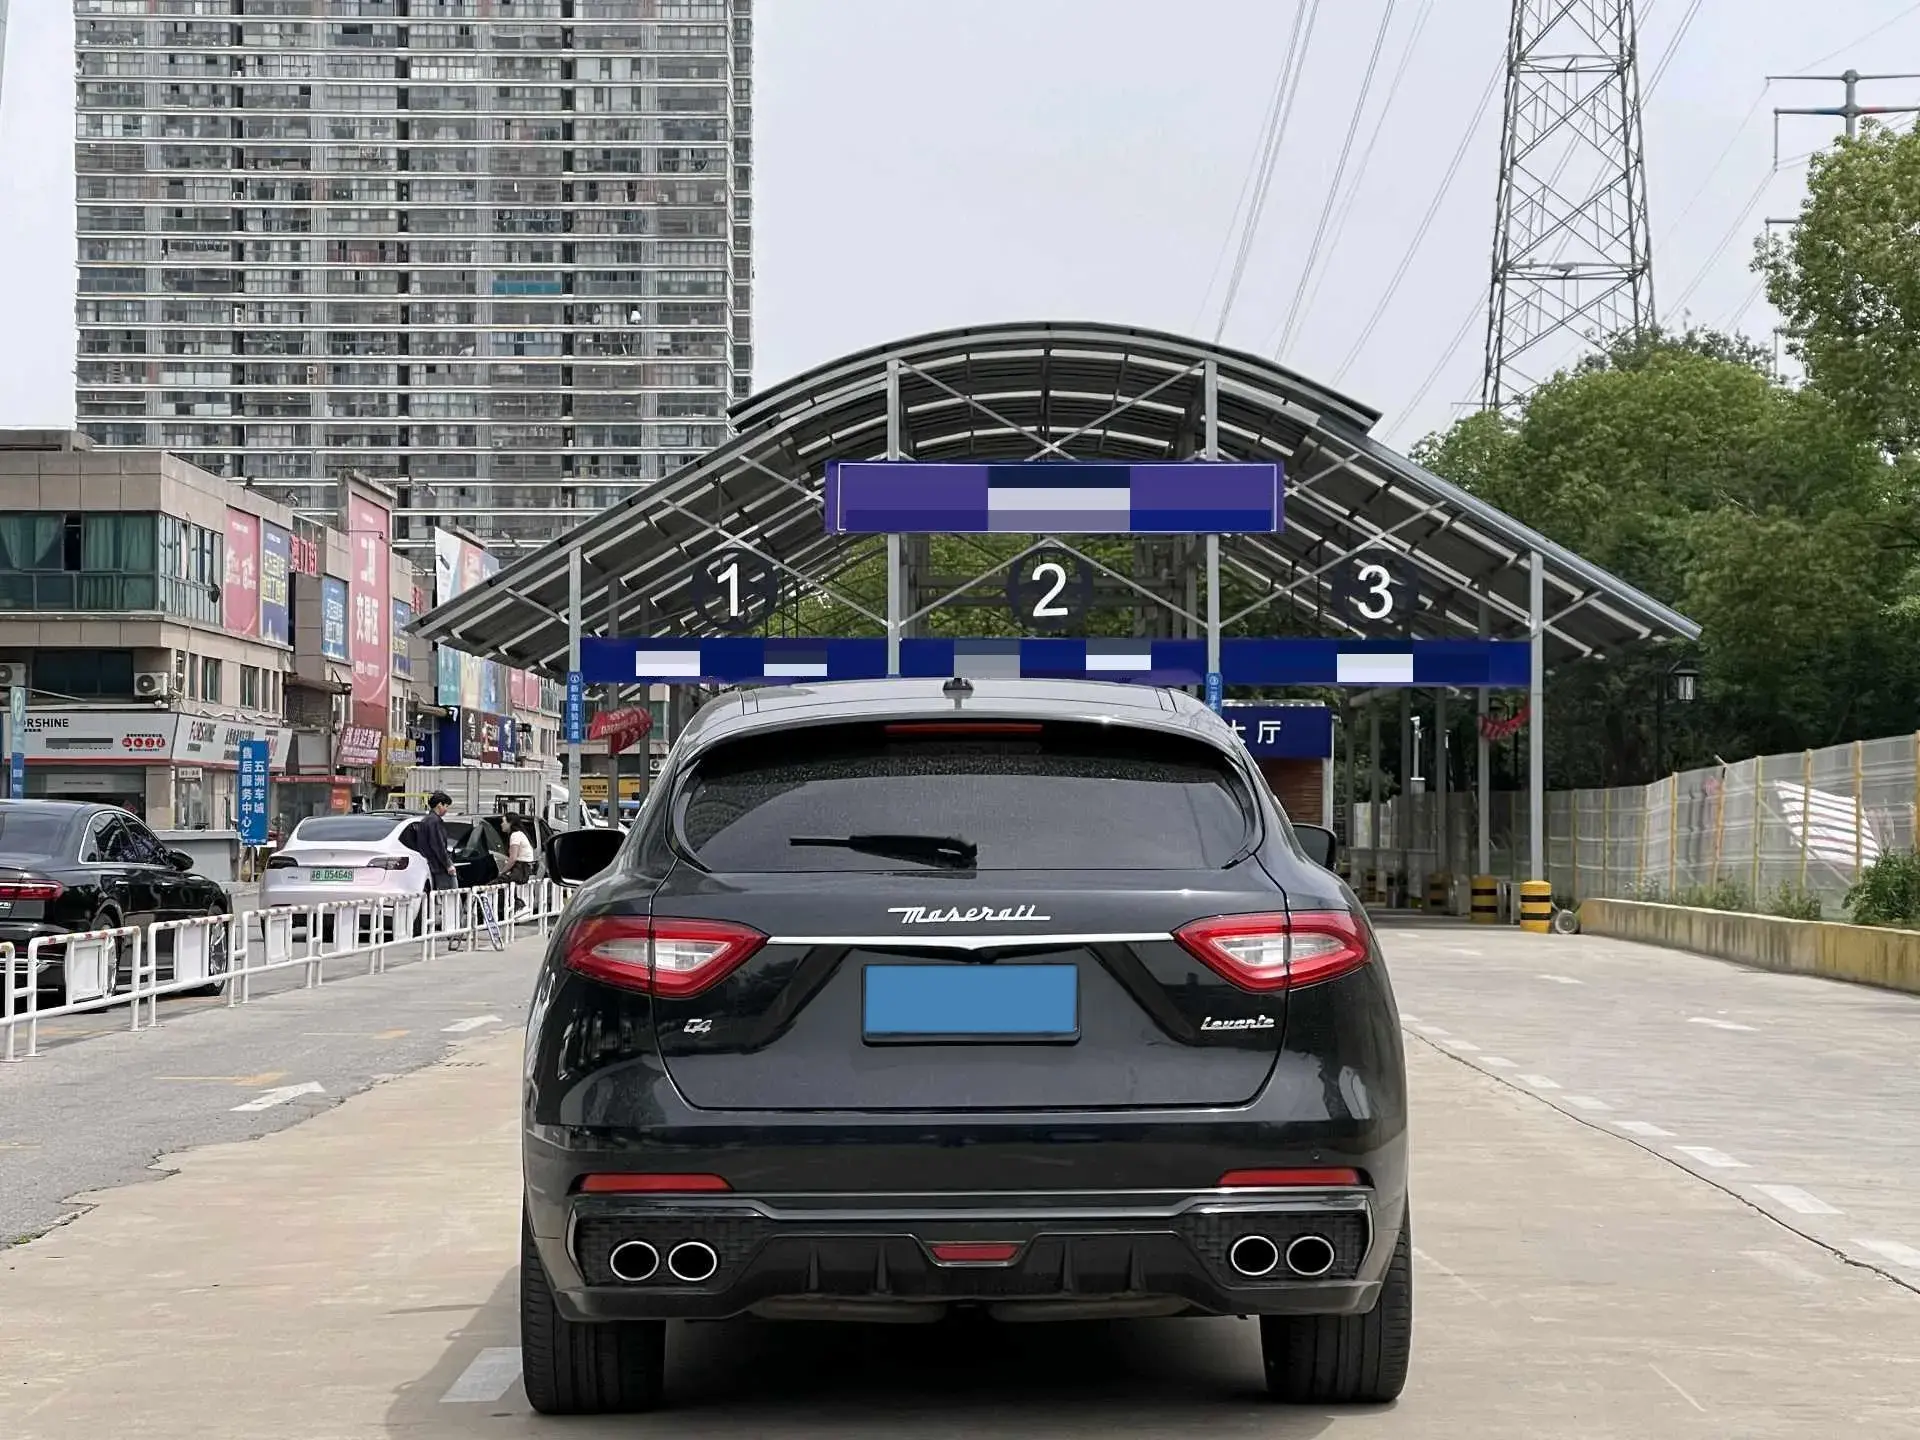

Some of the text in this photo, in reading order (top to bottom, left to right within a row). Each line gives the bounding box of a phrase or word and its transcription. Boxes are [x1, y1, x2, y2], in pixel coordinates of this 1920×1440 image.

[717, 563, 738, 617] 1
[1032, 563, 1068, 617] 2
[1357, 564, 1393, 619] 3
[254, 761, 265, 814] 五洲车城
[887, 904, 1051, 924] Maserati
[1200, 1014, 1275, 1031] Levante
